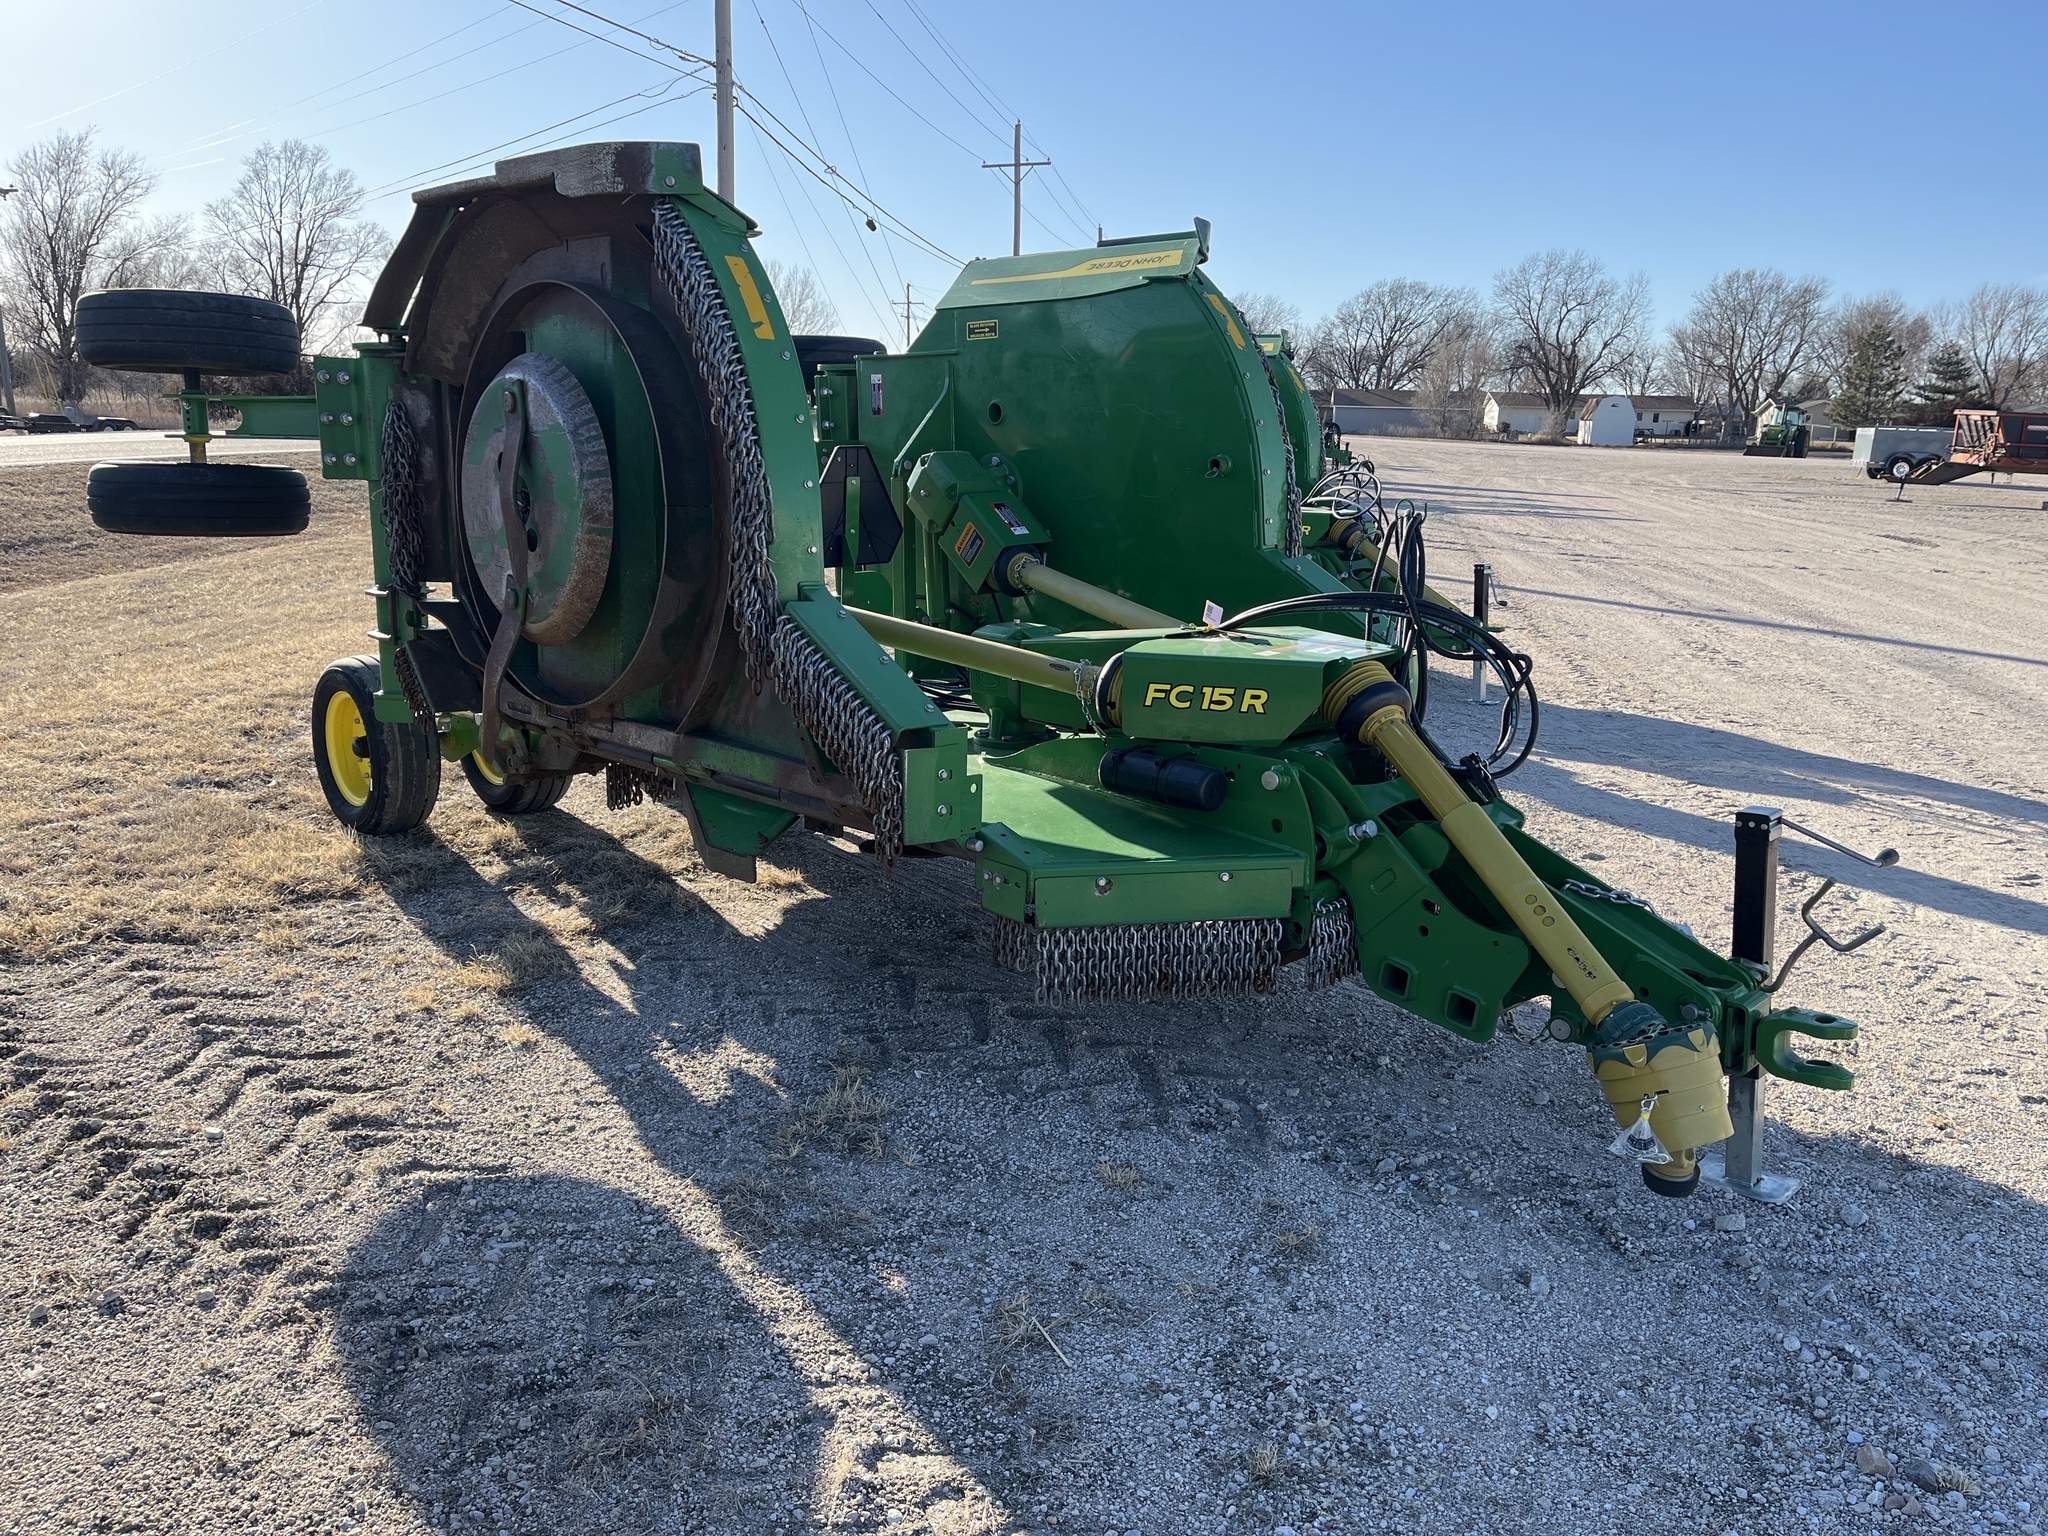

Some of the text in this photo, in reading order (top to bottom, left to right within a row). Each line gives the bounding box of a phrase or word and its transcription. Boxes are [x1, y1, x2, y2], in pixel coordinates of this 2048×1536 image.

[1086, 254, 1170, 271] JOHN DEERE
[1143, 682, 1270, 715] FC 15 R
